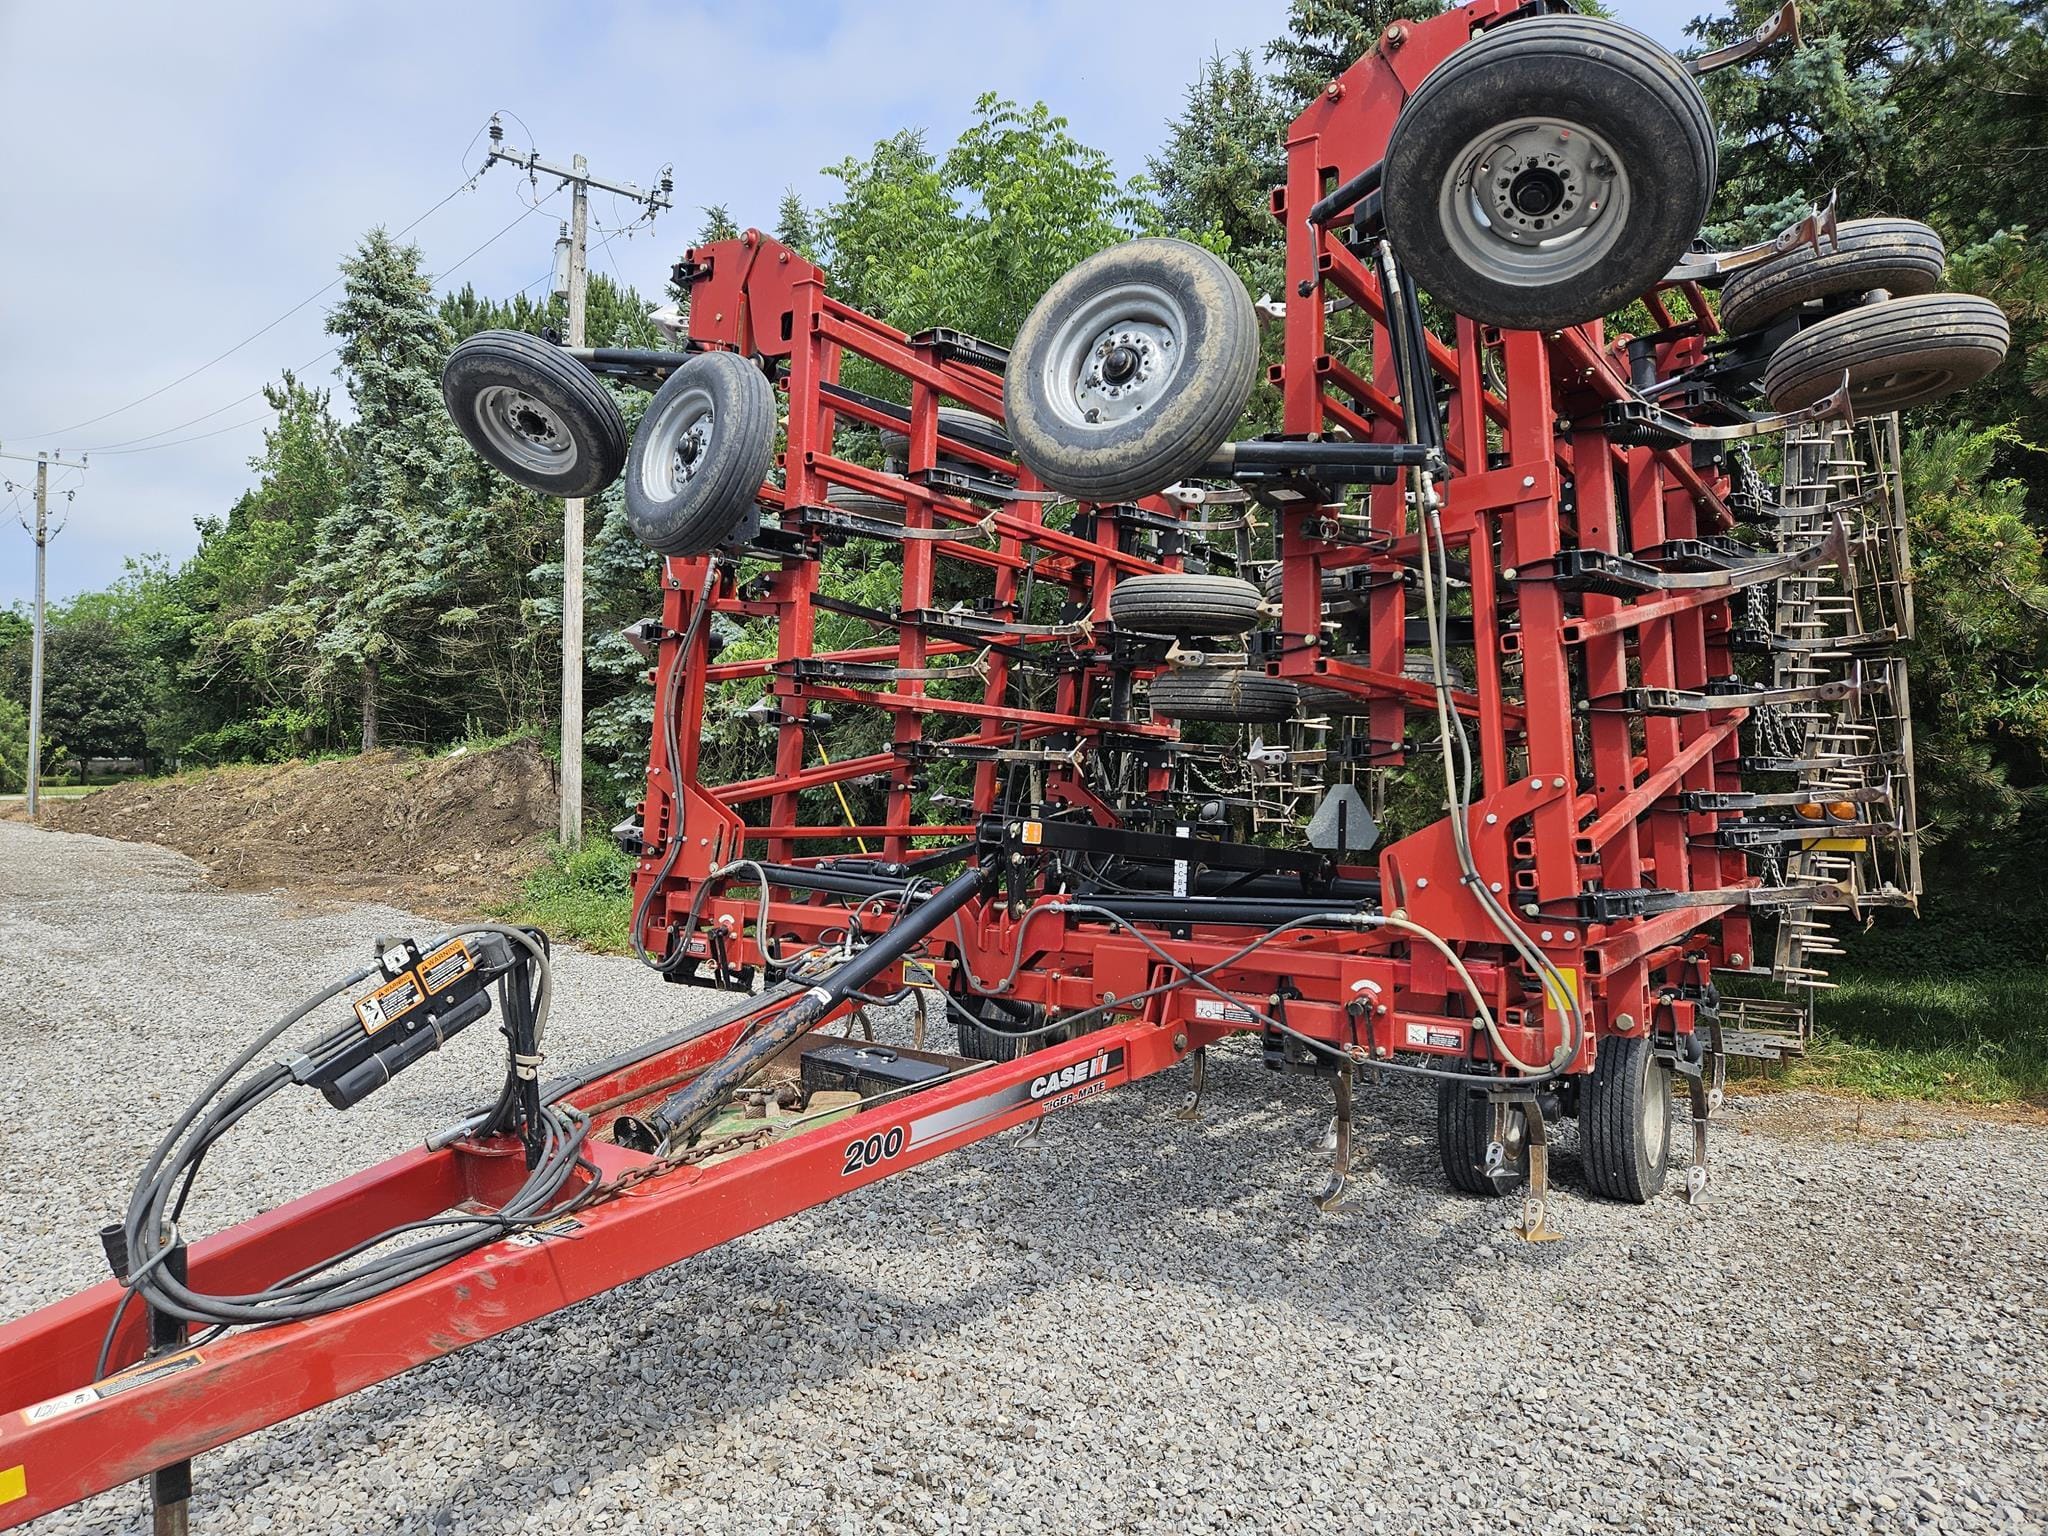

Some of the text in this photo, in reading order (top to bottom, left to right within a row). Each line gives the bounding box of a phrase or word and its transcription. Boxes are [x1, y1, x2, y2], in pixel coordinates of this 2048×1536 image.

[427, 943, 460, 966] WARNING
[1030, 1060, 1090, 1099] CASE
[841, 1125, 904, 1176] 200
